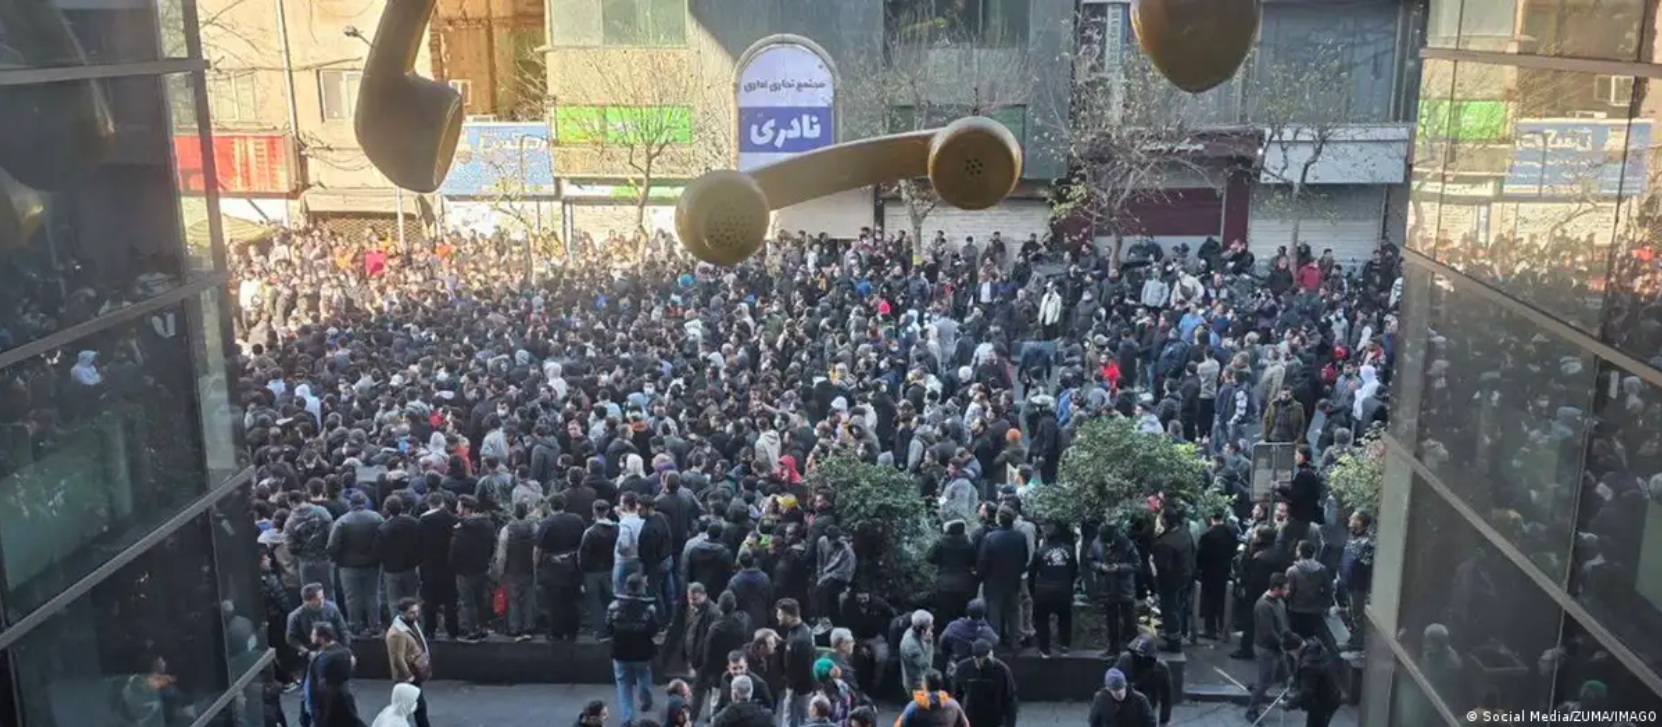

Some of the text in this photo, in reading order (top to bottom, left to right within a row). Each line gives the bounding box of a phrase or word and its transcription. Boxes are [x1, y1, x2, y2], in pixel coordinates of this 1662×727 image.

[744, 79, 825, 92] مجتمع تجاری اداری
[750, 114, 821, 149] نادری
